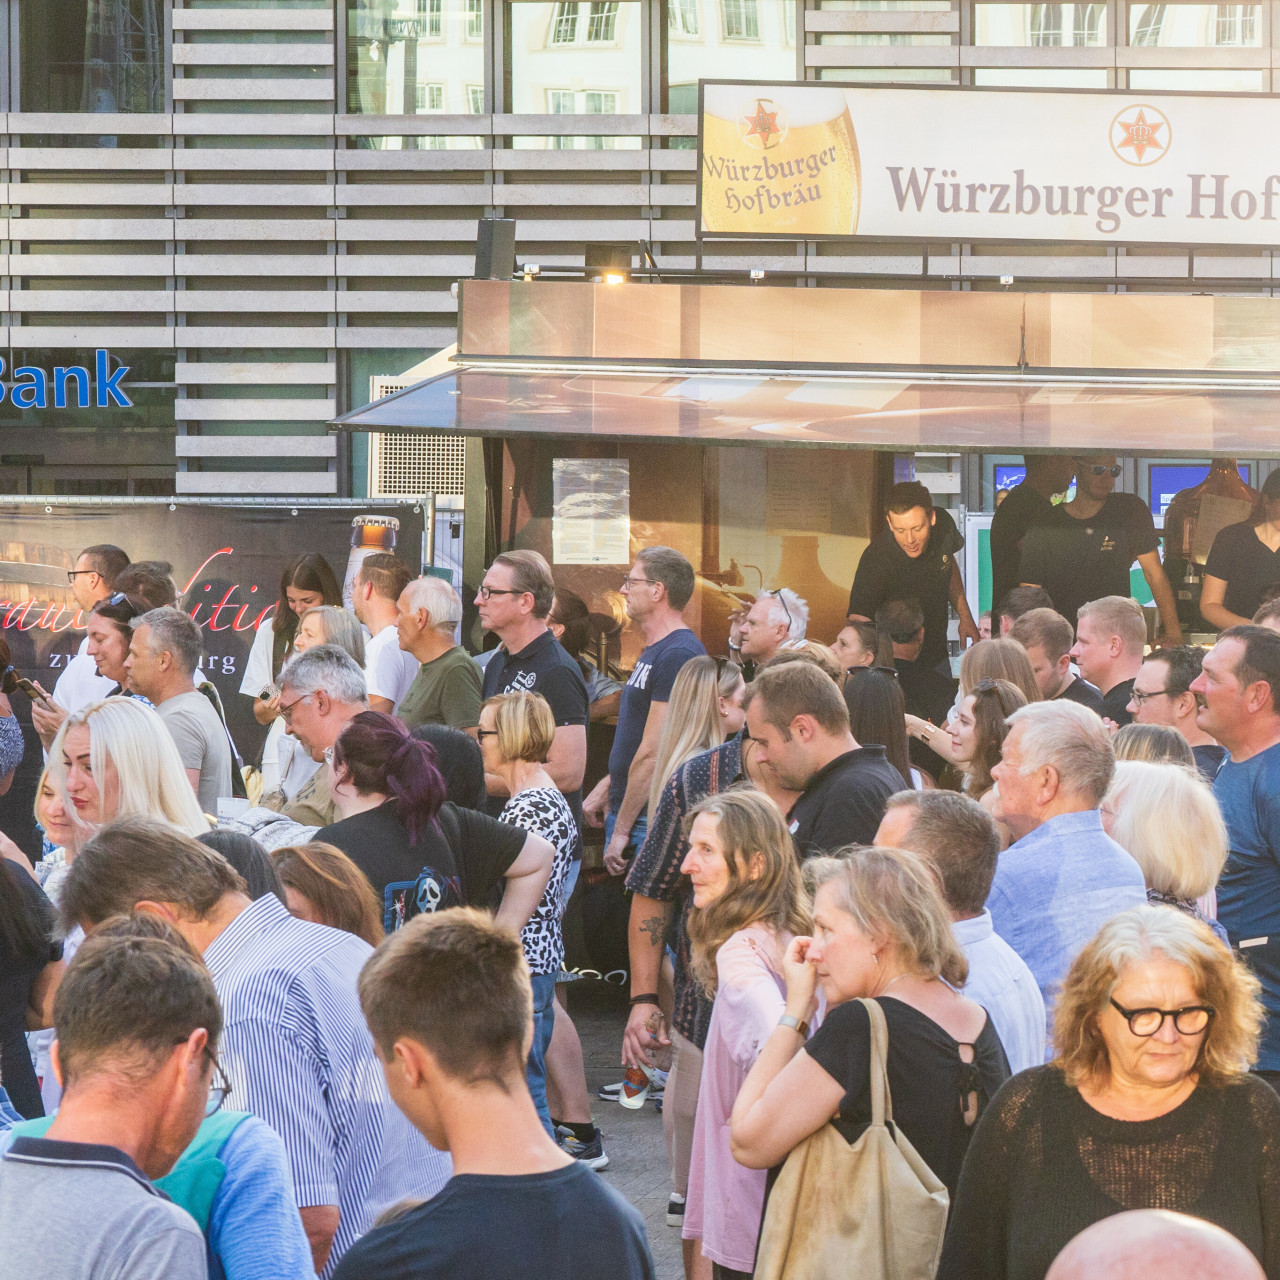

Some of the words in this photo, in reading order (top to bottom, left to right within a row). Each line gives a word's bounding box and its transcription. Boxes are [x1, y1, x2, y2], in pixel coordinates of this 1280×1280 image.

[702, 145, 837, 182] Würzburger
[724, 182, 823, 215] Hofbräu
[886, 165, 1174, 234] Würzburger
[0, 349, 134, 408] ank
